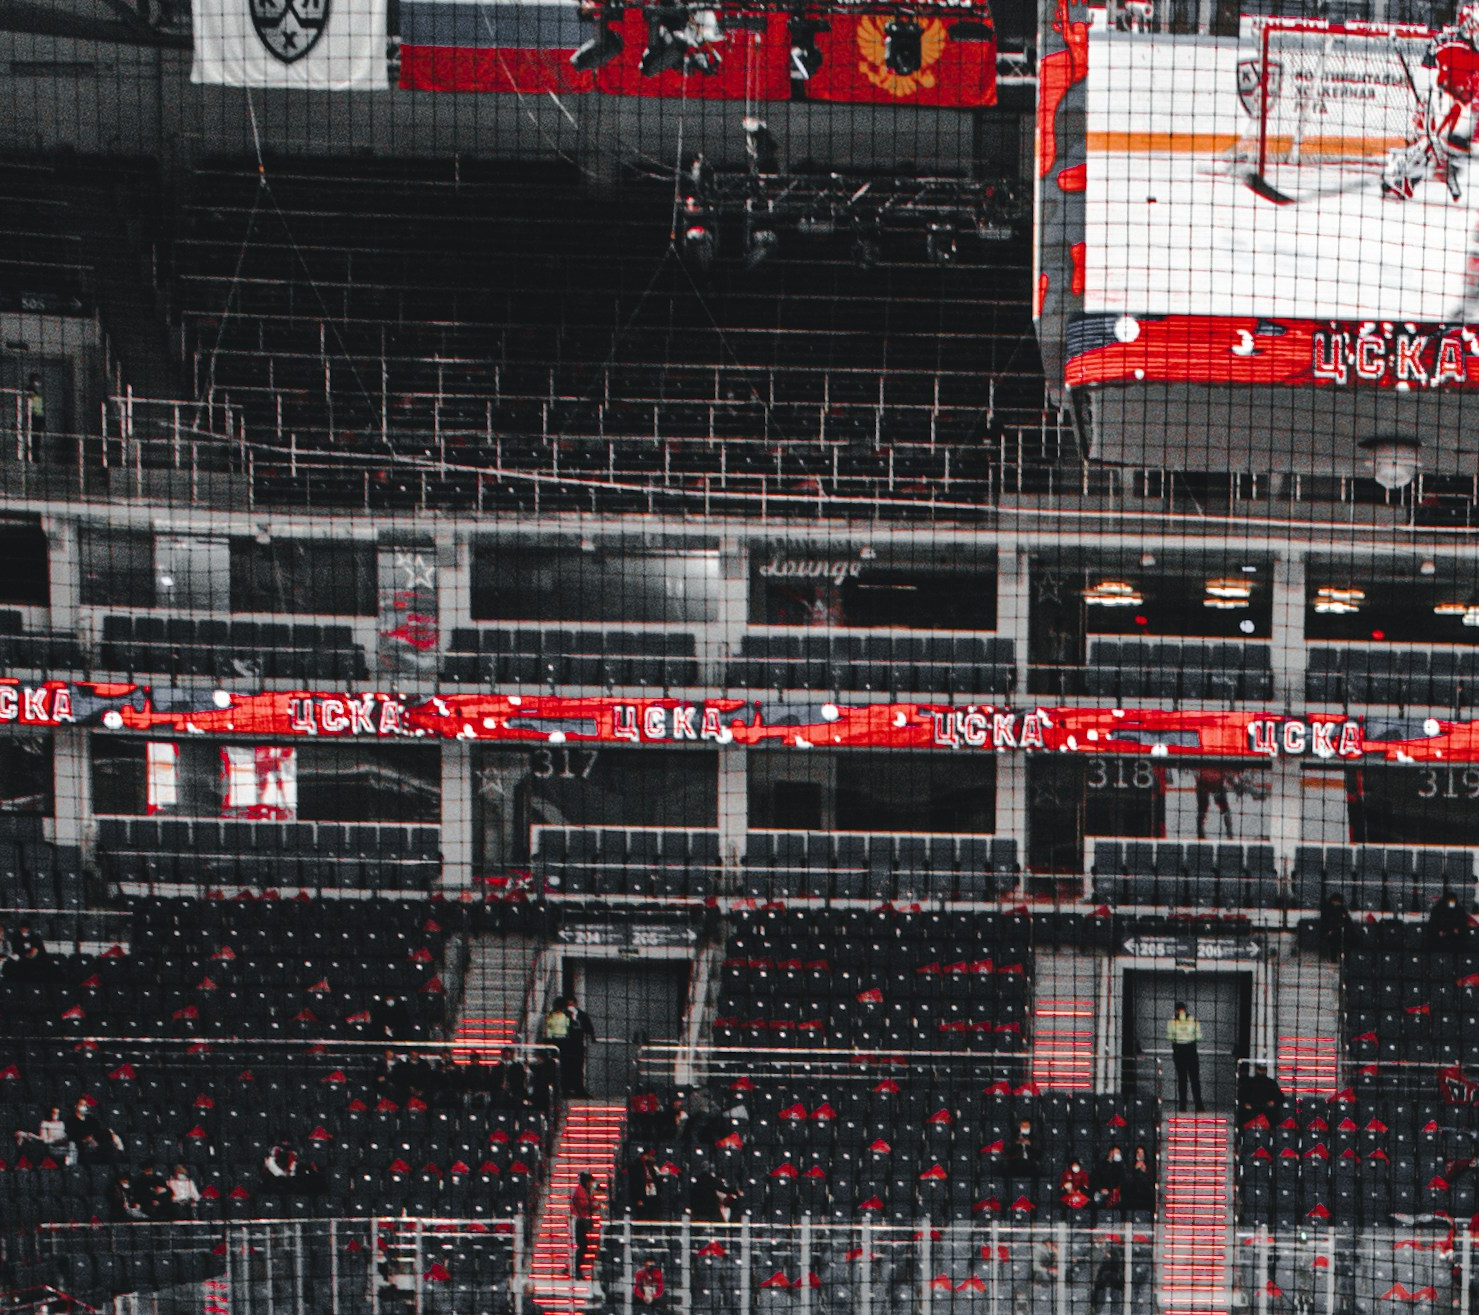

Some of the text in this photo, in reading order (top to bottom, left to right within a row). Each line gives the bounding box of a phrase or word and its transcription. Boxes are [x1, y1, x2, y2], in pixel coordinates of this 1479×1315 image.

[1313, 333, 1468, 384] ЦСКА
[759, 553, 864, 584] Lounge
[290, 694, 403, 737] ЦСКА
[613, 704, 724, 743] ЦСКА
[933, 708, 1047, 750] ЦСКА
[1250, 719, 1364, 757] ЦСКА
[533, 749, 598, 780] 317
[1086, 757, 1155, 790] 318
